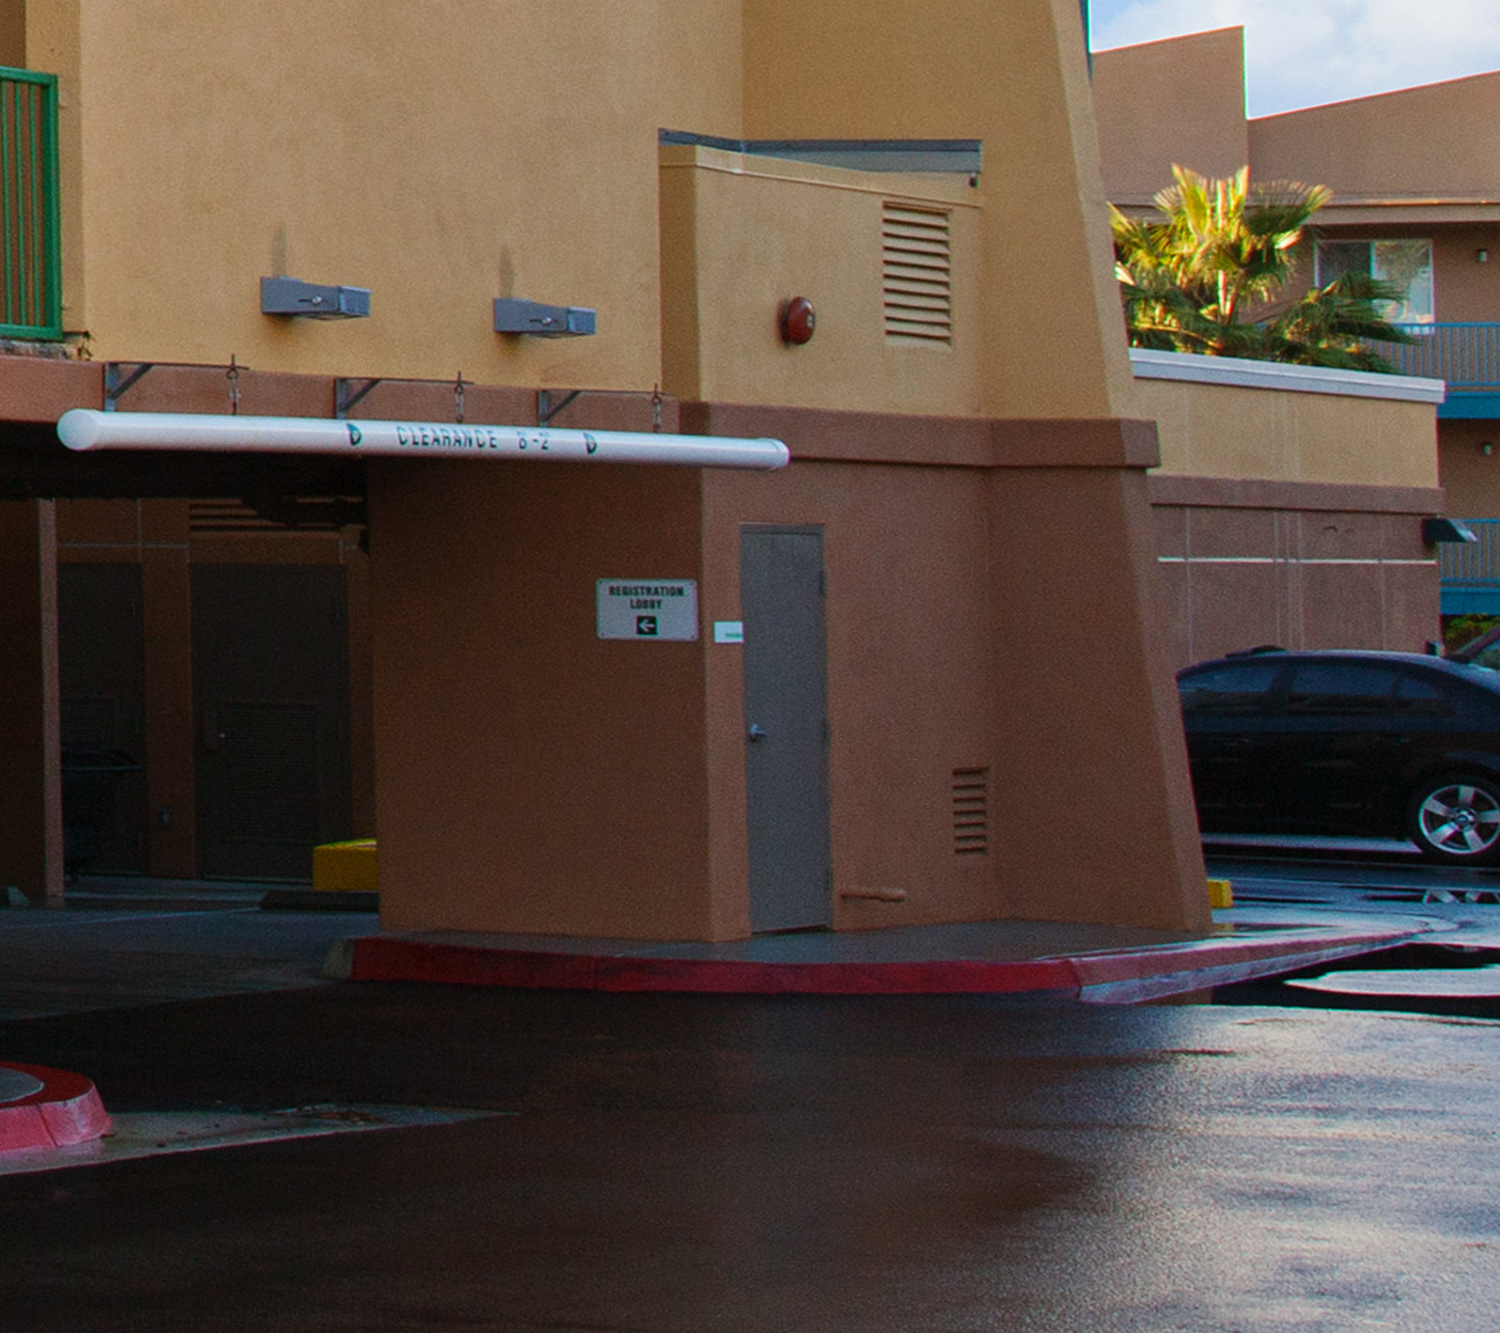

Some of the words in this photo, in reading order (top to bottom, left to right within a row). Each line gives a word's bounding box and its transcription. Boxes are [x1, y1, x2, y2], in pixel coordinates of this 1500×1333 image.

[396, 425, 498, 449] CLEARANCE
[609, 585, 685, 597] REGISTRATION
[630, 599, 663, 609] LOBBY
